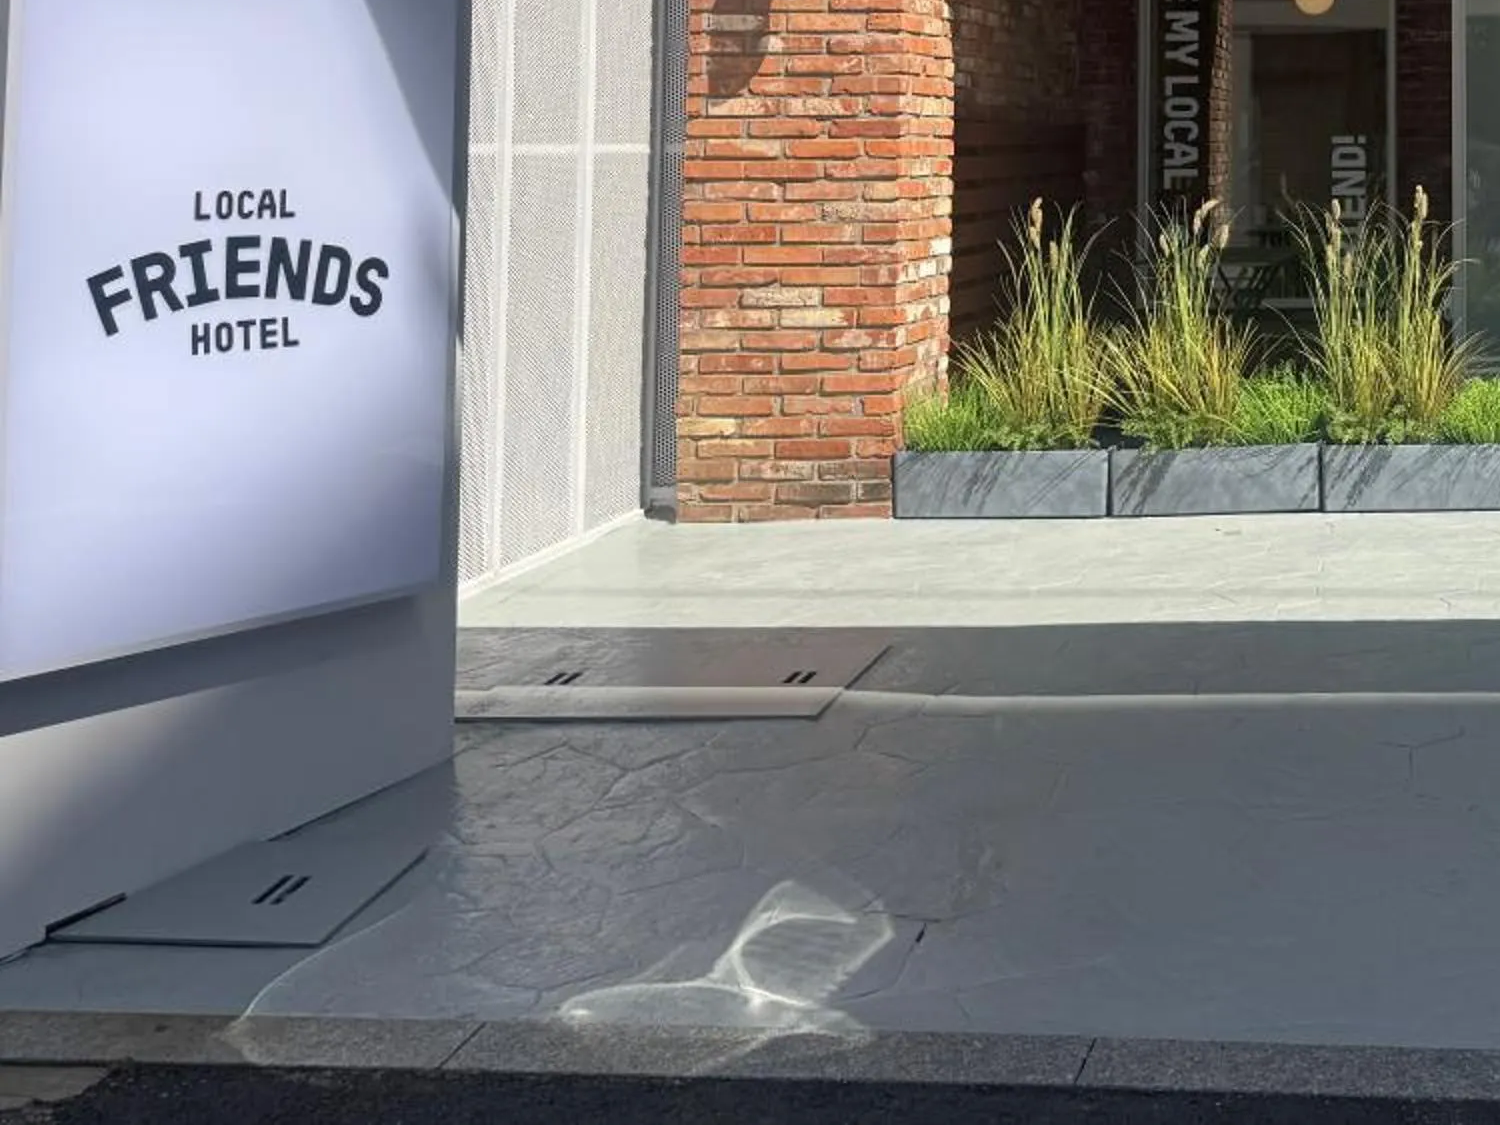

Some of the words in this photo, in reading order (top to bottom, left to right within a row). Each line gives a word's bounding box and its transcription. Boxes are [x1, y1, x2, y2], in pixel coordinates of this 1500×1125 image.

[1164, 11, 1199, 67] MY
[1163, 76, 1199, 190] LOCAL
[194, 188, 296, 221] LOCAL
[87, 235, 390, 336] FRIENDS
[190, 317, 300, 356] HOTEL
